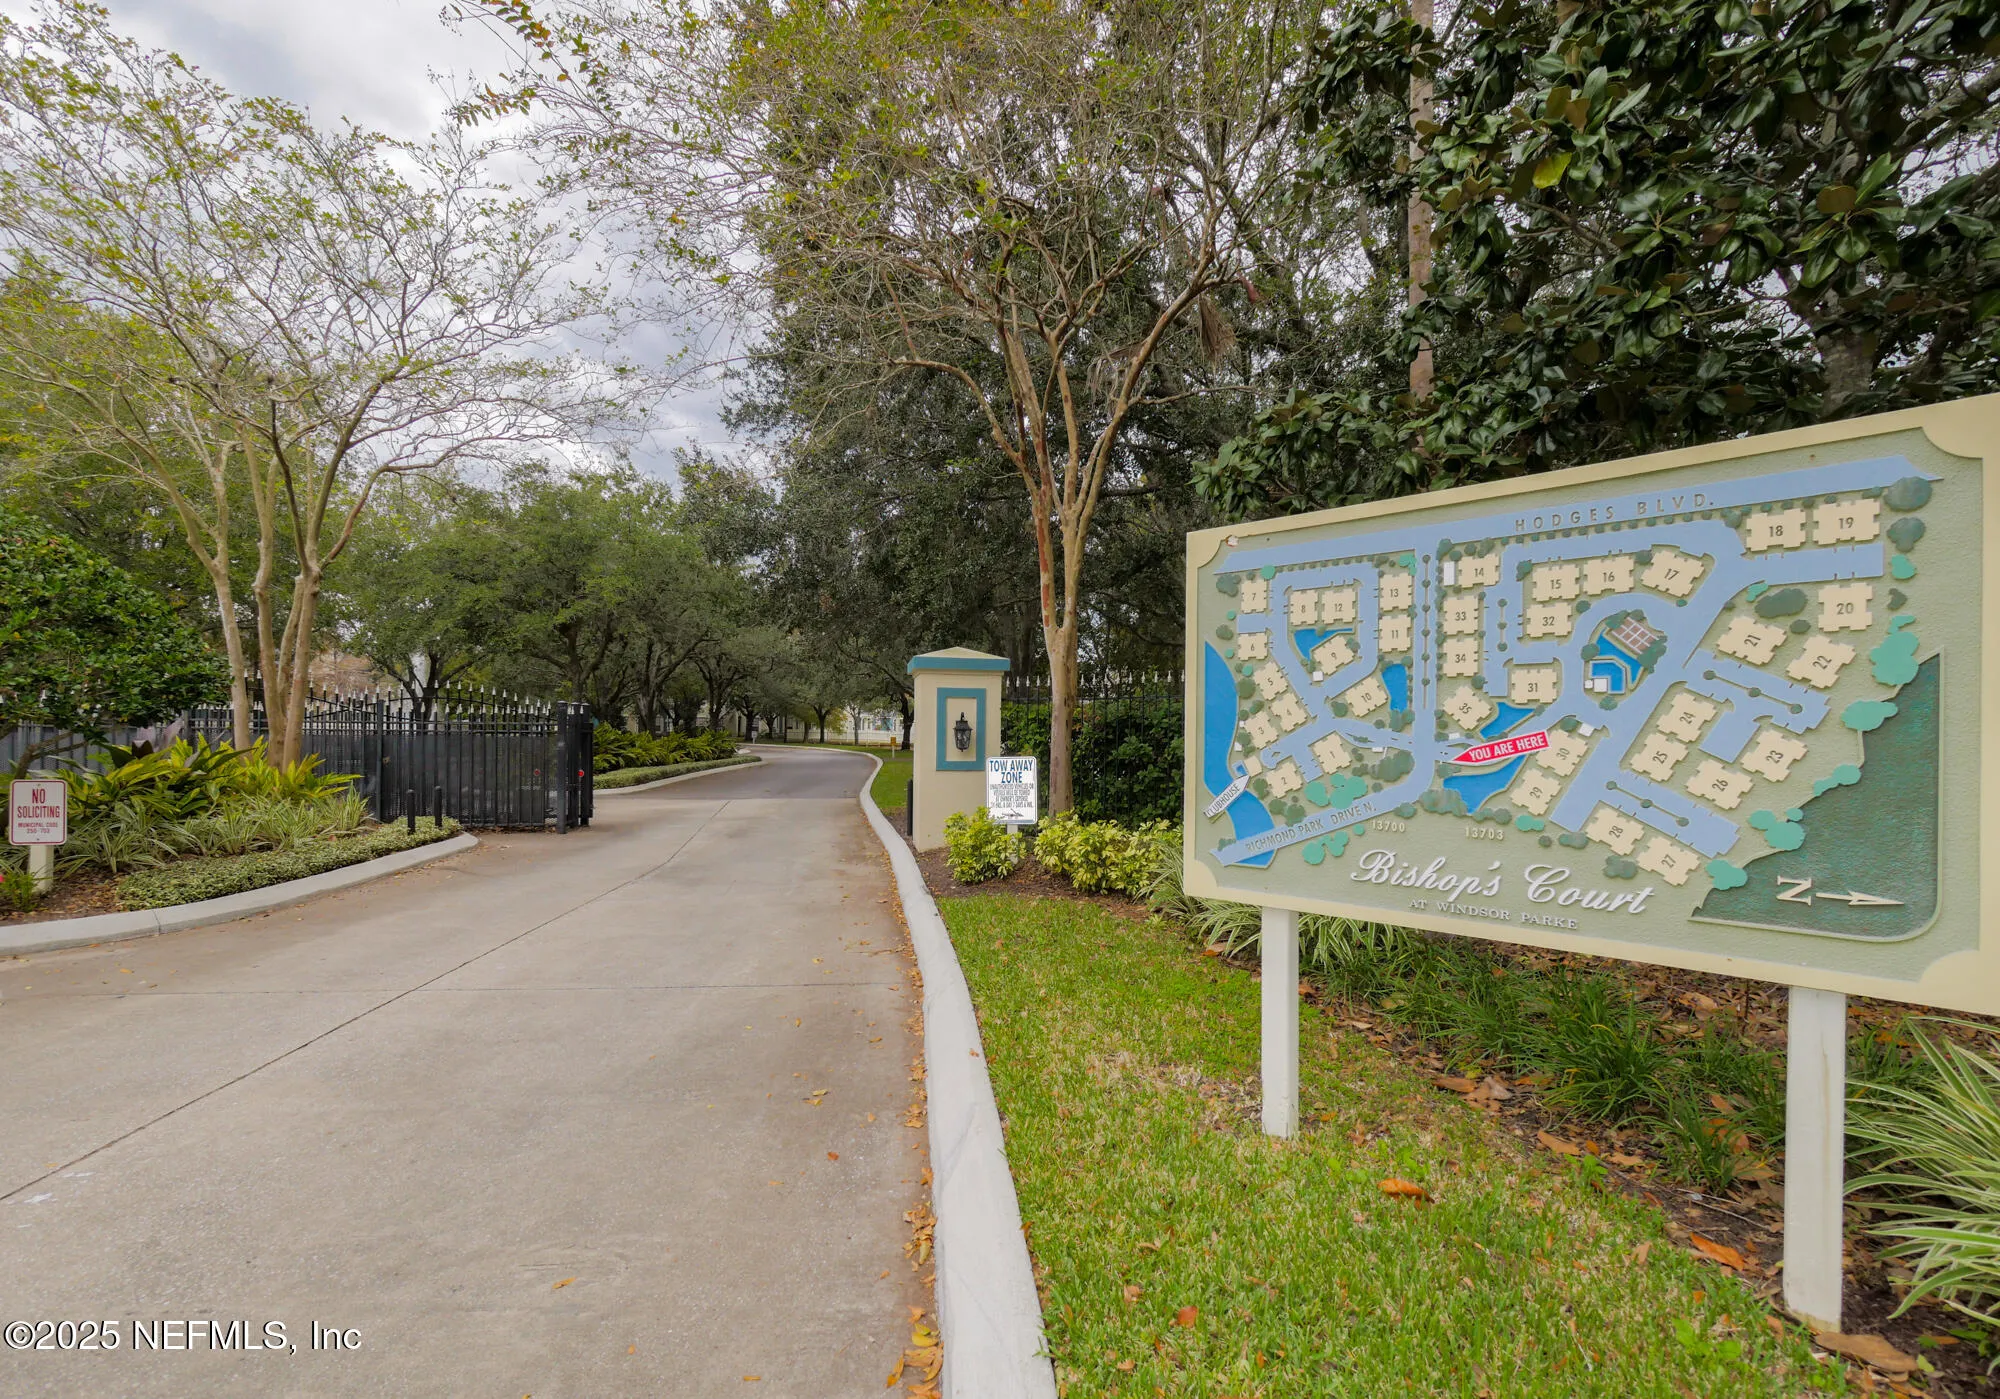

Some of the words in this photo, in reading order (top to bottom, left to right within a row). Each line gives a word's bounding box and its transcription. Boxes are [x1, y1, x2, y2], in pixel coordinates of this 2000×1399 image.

[1515, 506, 1615, 531] HODGES
[1637, 493, 1714, 515] BLVD.
[1838, 516, 1855, 529] 19
[1768, 525, 1784, 538] 18
[1474, 567, 1485, 577] 14
[1603, 571, 1616, 582] 16
[1664, 568, 1680, 581] 17
[1550, 579, 1562, 590] 15
[1251, 592, 1257, 601] 7
[1389, 588, 1399, 598] 13
[1300, 604, 1306, 614] 8
[1334, 602, 1343, 612] 12
[1836, 602, 1854, 615] 20
[1454, 611, 1467, 621] 33
[1542, 615, 1555, 627] 32
[1391, 629, 1399, 640] 11
[1744, 634, 1761, 647] 21
[1250, 642, 1255, 652] 6
[1330, 652, 1337, 661] 9
[1454, 653, 1467, 664] 34
[1813, 655, 1832, 670] 22
[1267, 677, 1274, 686] 5
[1527, 682, 1539, 693] 31
[1361, 691, 1372, 702] 10
[1459, 703, 1472, 714] 35
[1679, 711, 1696, 725] 24
[1258, 726, 1265, 735] 3
[1468, 747, 1491, 761] YOU
[1493, 741, 1515, 757] ARE
[1515, 734, 1546, 751] HERE
[1556, 748, 1571, 760] 30
[1652, 750, 1668, 764] 25
[1765, 750, 1784, 764] 23
[990, 760, 1008, 772] TOW
[1010, 759, 1033, 771] AWAY
[1001, 771, 1022, 784] ZONE
[1281, 776, 1287, 785] 2
[1711, 778, 1729, 792] 26
[32, 788, 46, 804] NO
[1206, 783, 1240, 815] CLUBHOUSE
[1530, 786, 1544, 799] 29
[17, 805, 60, 818] SOLICITING
[1245, 829, 1296, 852] RICHMOND
[1298, 818, 1323, 836] PARK
[1330, 804, 1362, 826] DRIVE
[1372, 819, 1406, 833] 13700
[1608, 825, 1624, 839] 28
[1464, 826, 1505, 841] 13703
[1661, 854, 1677, 869] 27
[1350, 849, 1503, 903] Bishop's
[1523, 863, 1655, 915] Court
[1777, 875, 1812, 906] N
[1408, 898, 1428, 909] AT
[1436, 901, 1511, 922] WINDSOR
[1520, 912, 1579, 930] PARKE
